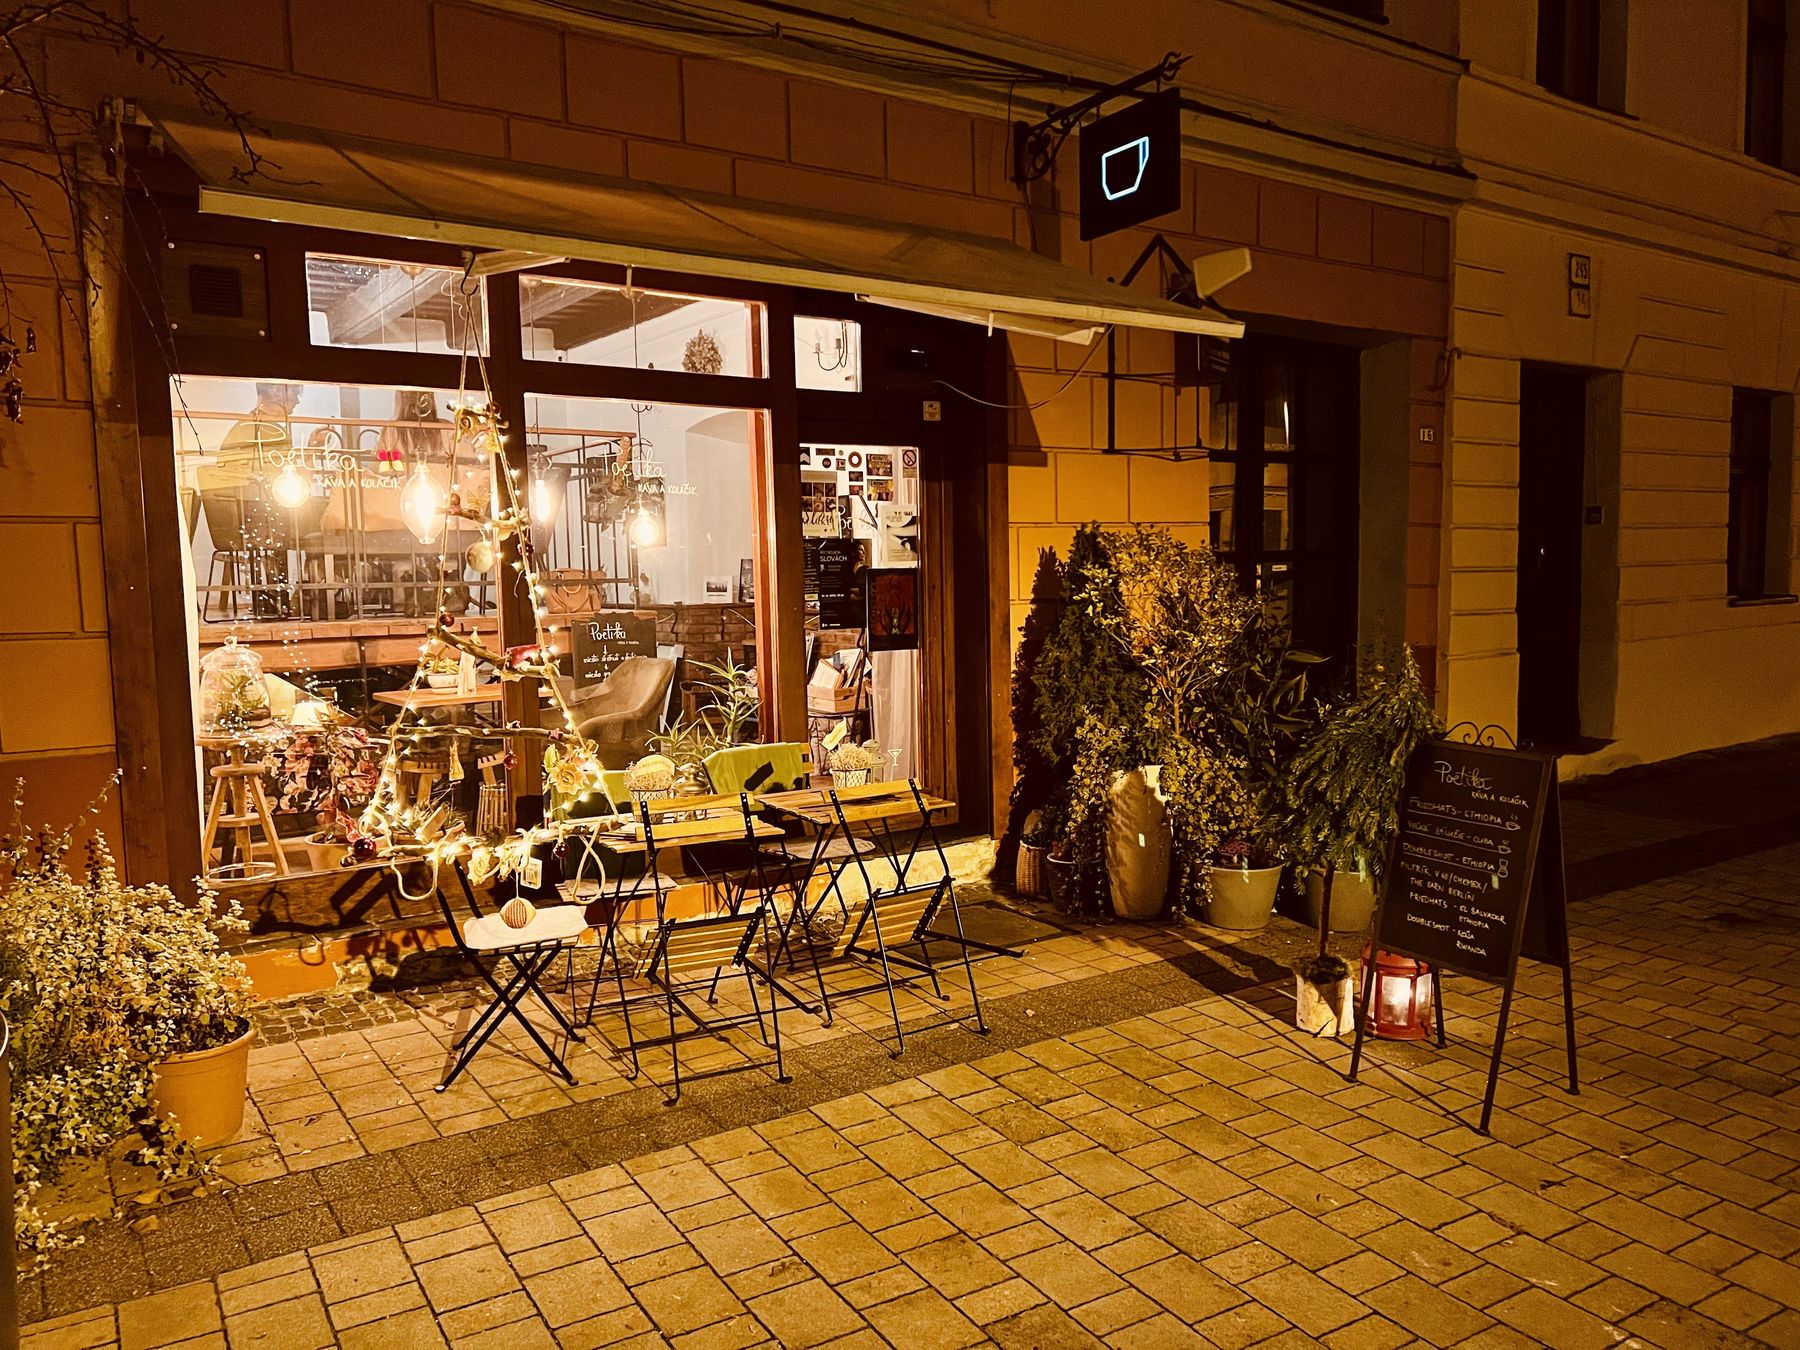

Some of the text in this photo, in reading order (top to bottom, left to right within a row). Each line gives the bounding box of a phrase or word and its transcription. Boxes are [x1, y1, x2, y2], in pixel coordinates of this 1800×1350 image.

[1422, 429, 1433, 440] 16
[239, 421, 372, 473] Poetika
[586, 438, 667, 478] Poetika
[317, 475, 402, 490] KÁVA A KOLÁČIK
[659, 485, 666, 494] A
[820, 554, 848, 562] SLOVÁCH
[588, 621, 627, 641] Poetika
[1434, 760, 1493, 790] Poetika
[1471, 789, 1489, 801] KÁVA
[1464, 809, 1502, 824] ETHIOPIA
[1462, 856, 1495, 871] ETHIOPIA
[1411, 877, 1423, 888] THE
[1409, 890, 1448, 908] FRIEDHATS
[1470, 906, 1507, 925] SALVADOR
[1407, 913, 1451, 931] DOUBLESHOT
[1459, 915, 1490, 930] ETHIOPIA
[1456, 940, 1487, 957] RWANDA
